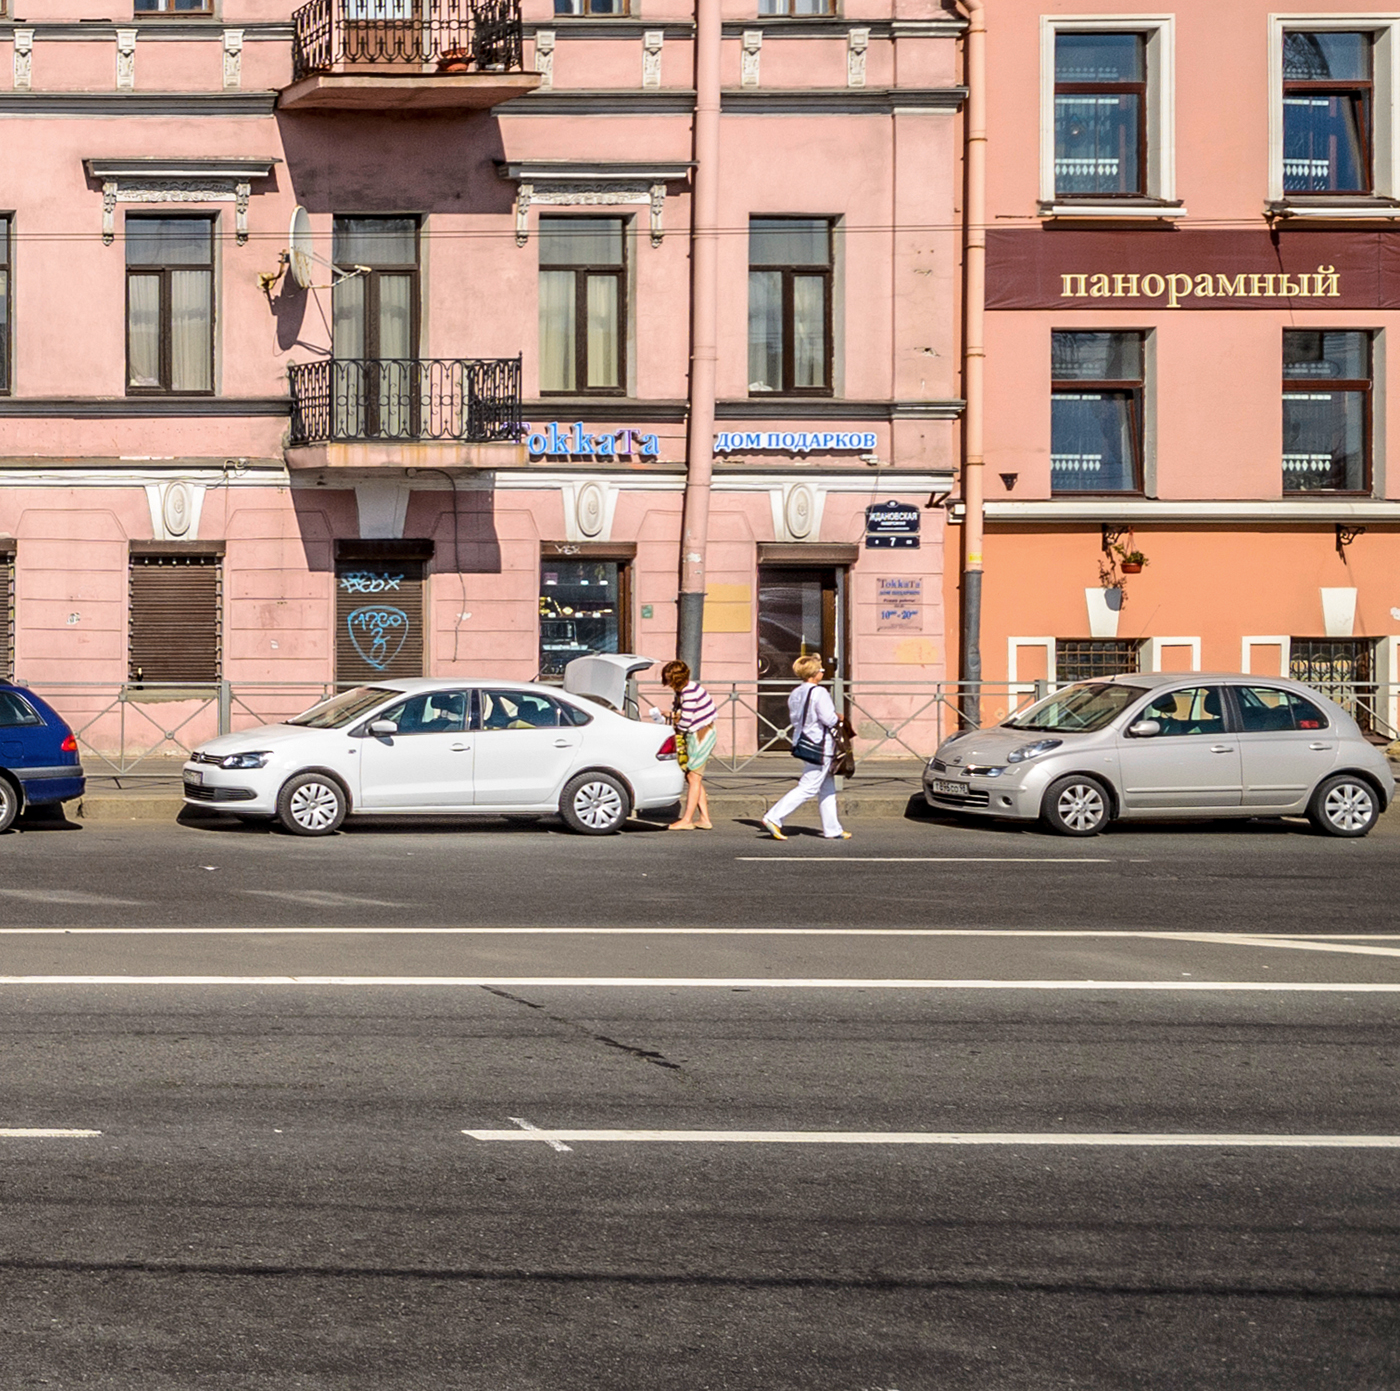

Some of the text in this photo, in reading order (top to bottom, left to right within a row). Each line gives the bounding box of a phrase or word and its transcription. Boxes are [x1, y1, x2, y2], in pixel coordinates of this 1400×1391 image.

[1060, 265, 1340, 308] панорамный
[715, 433, 877, 452] ДОМ ПОДАРКОВ
[868, 512, 918, 522] ЖДАНОВСКАЯ
[889, 537, 896, 547] 7
